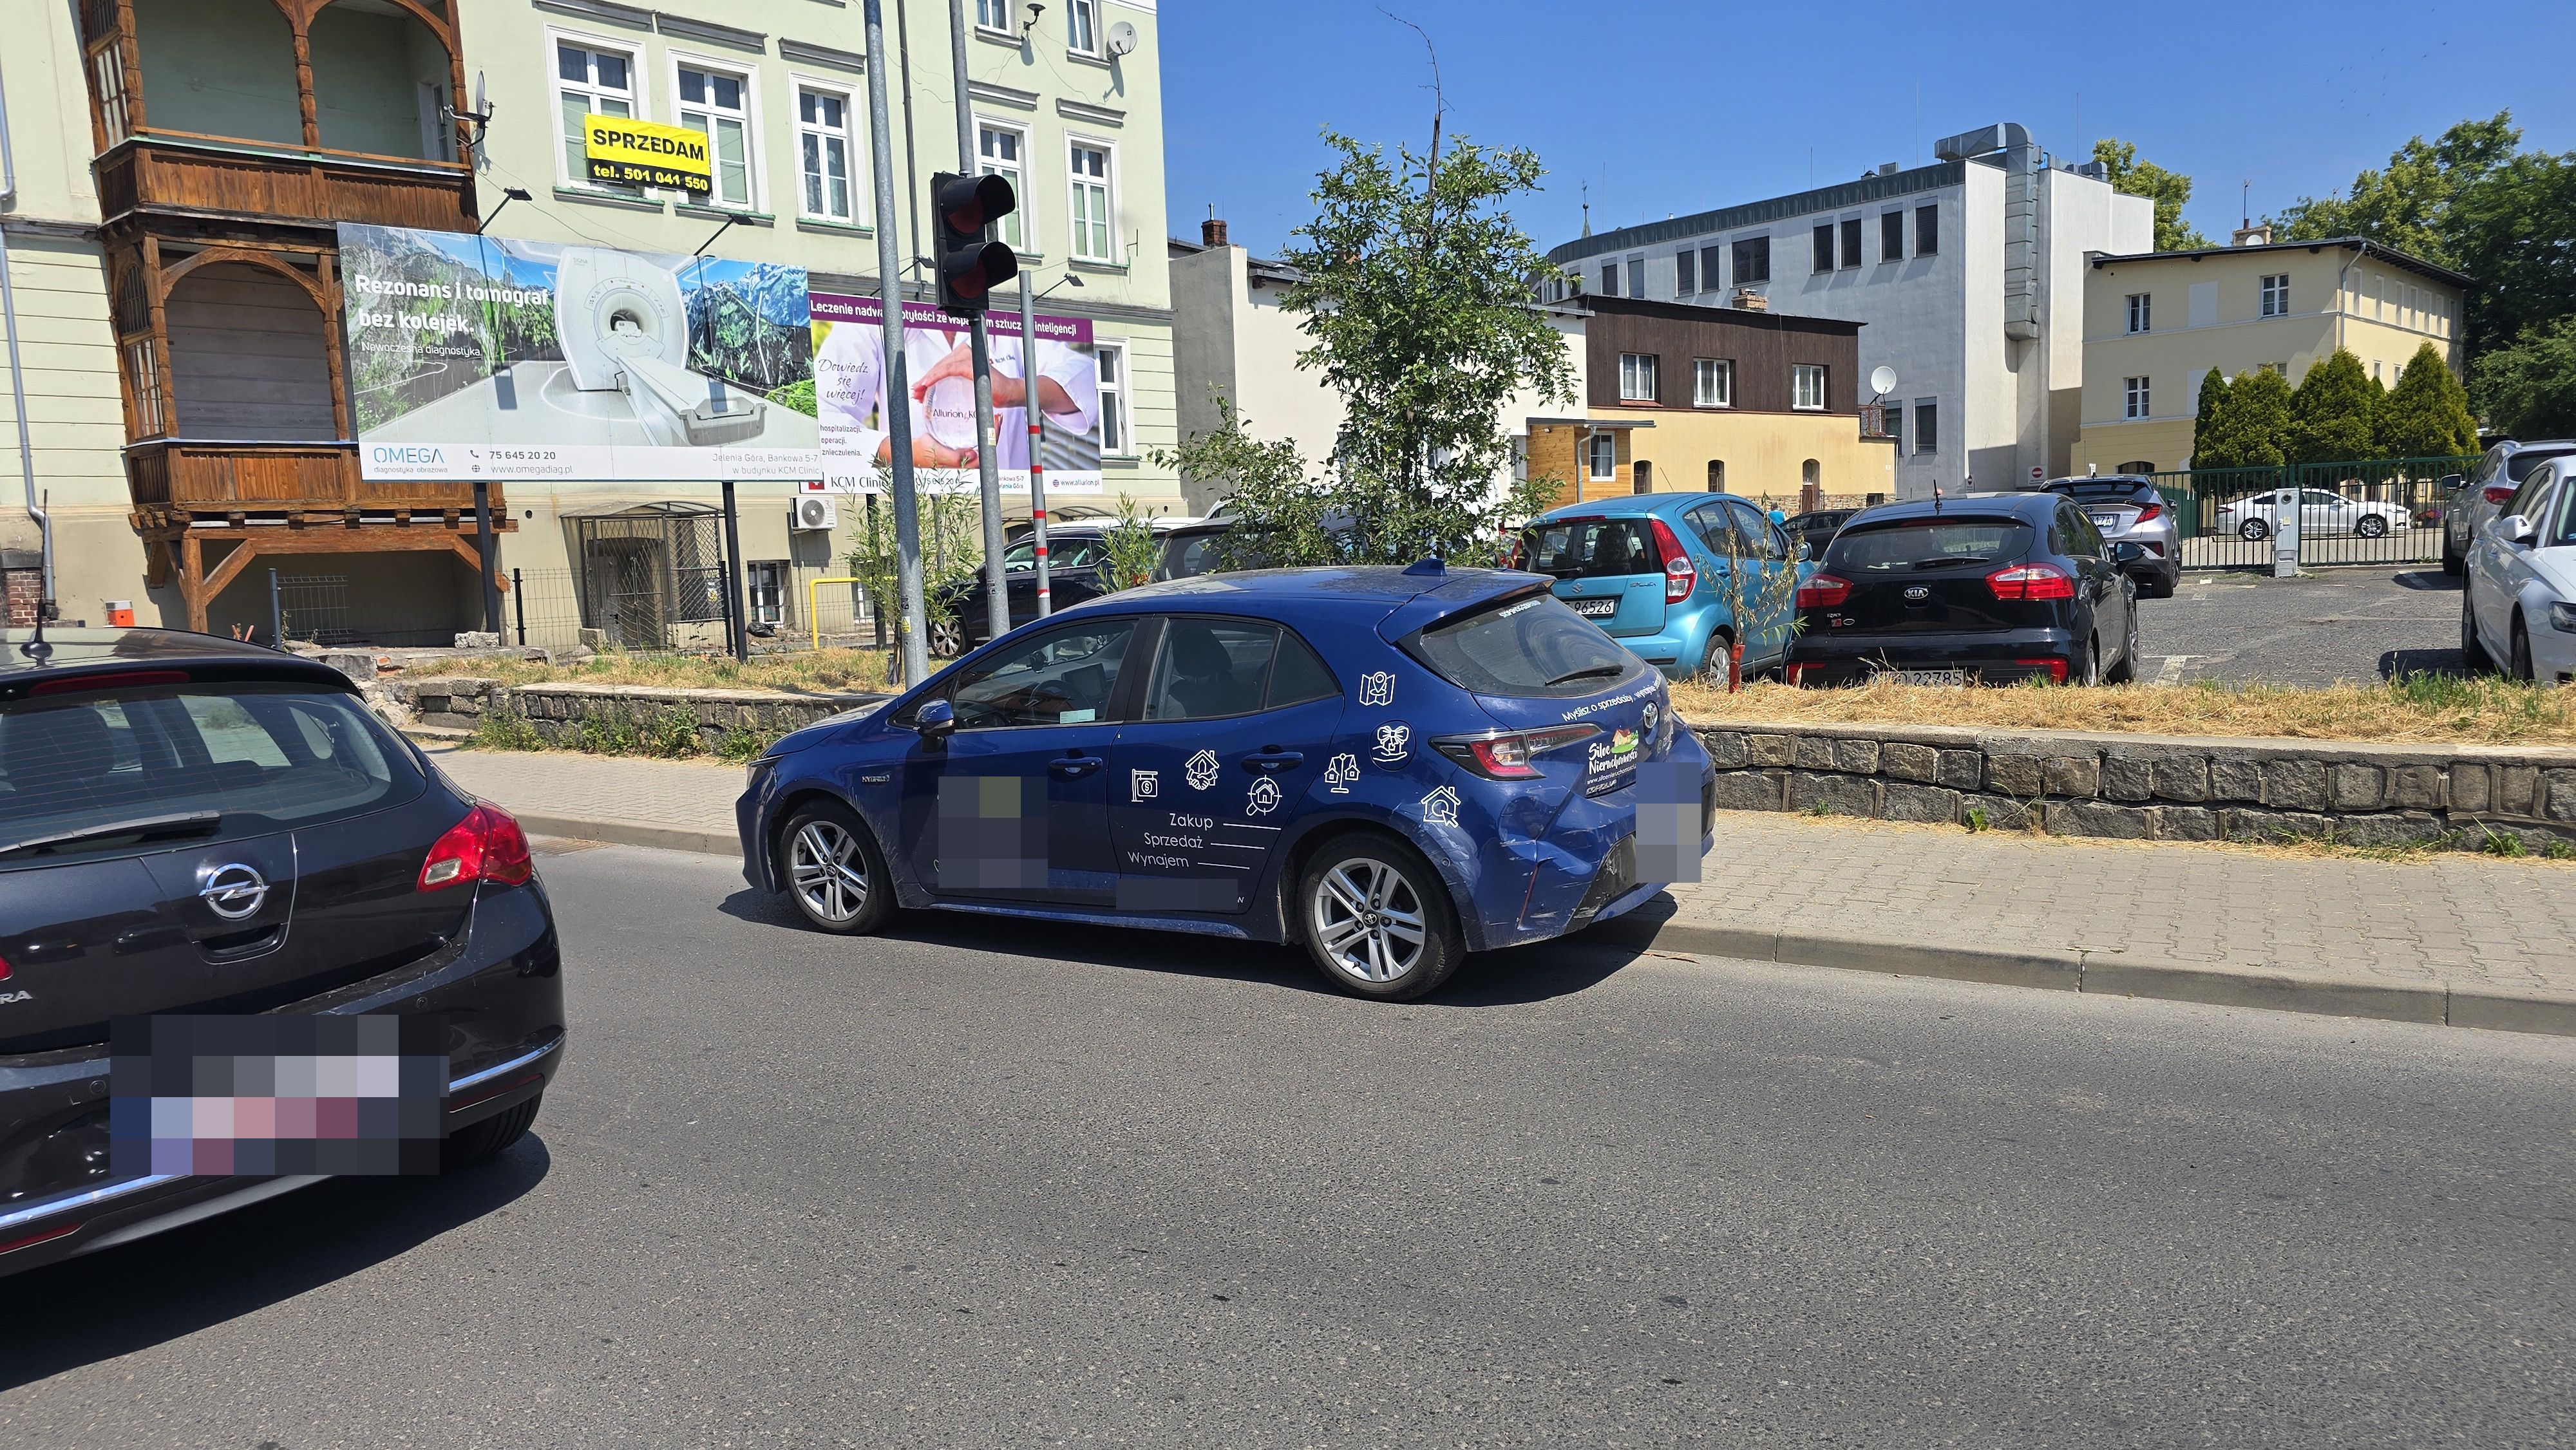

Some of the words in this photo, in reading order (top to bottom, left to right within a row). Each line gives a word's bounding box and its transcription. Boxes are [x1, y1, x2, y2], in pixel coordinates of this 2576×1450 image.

[592, 129, 705, 161] SPRZEDAM
[594, 164, 620, 178] tel.
[624, 167, 650, 182] 501
[655, 171, 680, 185] 041
[685, 176, 708, 191] 550
[354, 274, 451, 299] Rezonans
[455, 281, 462, 299] i
[466, 284, 549, 308] tomograf
[359, 308, 395, 328] bez
[398, 310, 475, 334] kolejek.
[810, 300, 853, 315] Leczenie
[936, 314, 947, 323] ze
[995, 319, 1022, 330] sztucz
[1035, 321, 1077, 337] inteligencji
[361, 341, 423, 355] Nowoczesna
[819, 359, 868, 373] Dowiedz
[837, 375, 851, 388] się
[826, 389, 866, 406] więcej!
[933, 409, 964, 419] Allurion
[374, 447, 444, 464] OMEGA
[489, 451, 502, 460] 75
[505, 451, 525, 460] 645
[527, 451, 540, 460] 20
[543, 451, 556, 460] 20
[712, 453, 742, 462] Jelenia
[744, 453, 766, 463] Góra,
[374, 466, 413, 474] diagnostyka
[491, 466, 574, 475] www.omegadiag.pl
[741, 466, 775, 476] budynku
[831, 476, 855, 488] KCM
[1908, 588, 1926, 598] KIA
[1574, 601, 1612, 613] 96526
[1591, 704, 1598, 712] o
[1588, 742, 1611, 760] Siloe
[1169, 813, 1213, 831] Zakup
[1144, 832, 1204, 849] Sprzedaż
[1127, 851, 1189, 869] Wynajem
